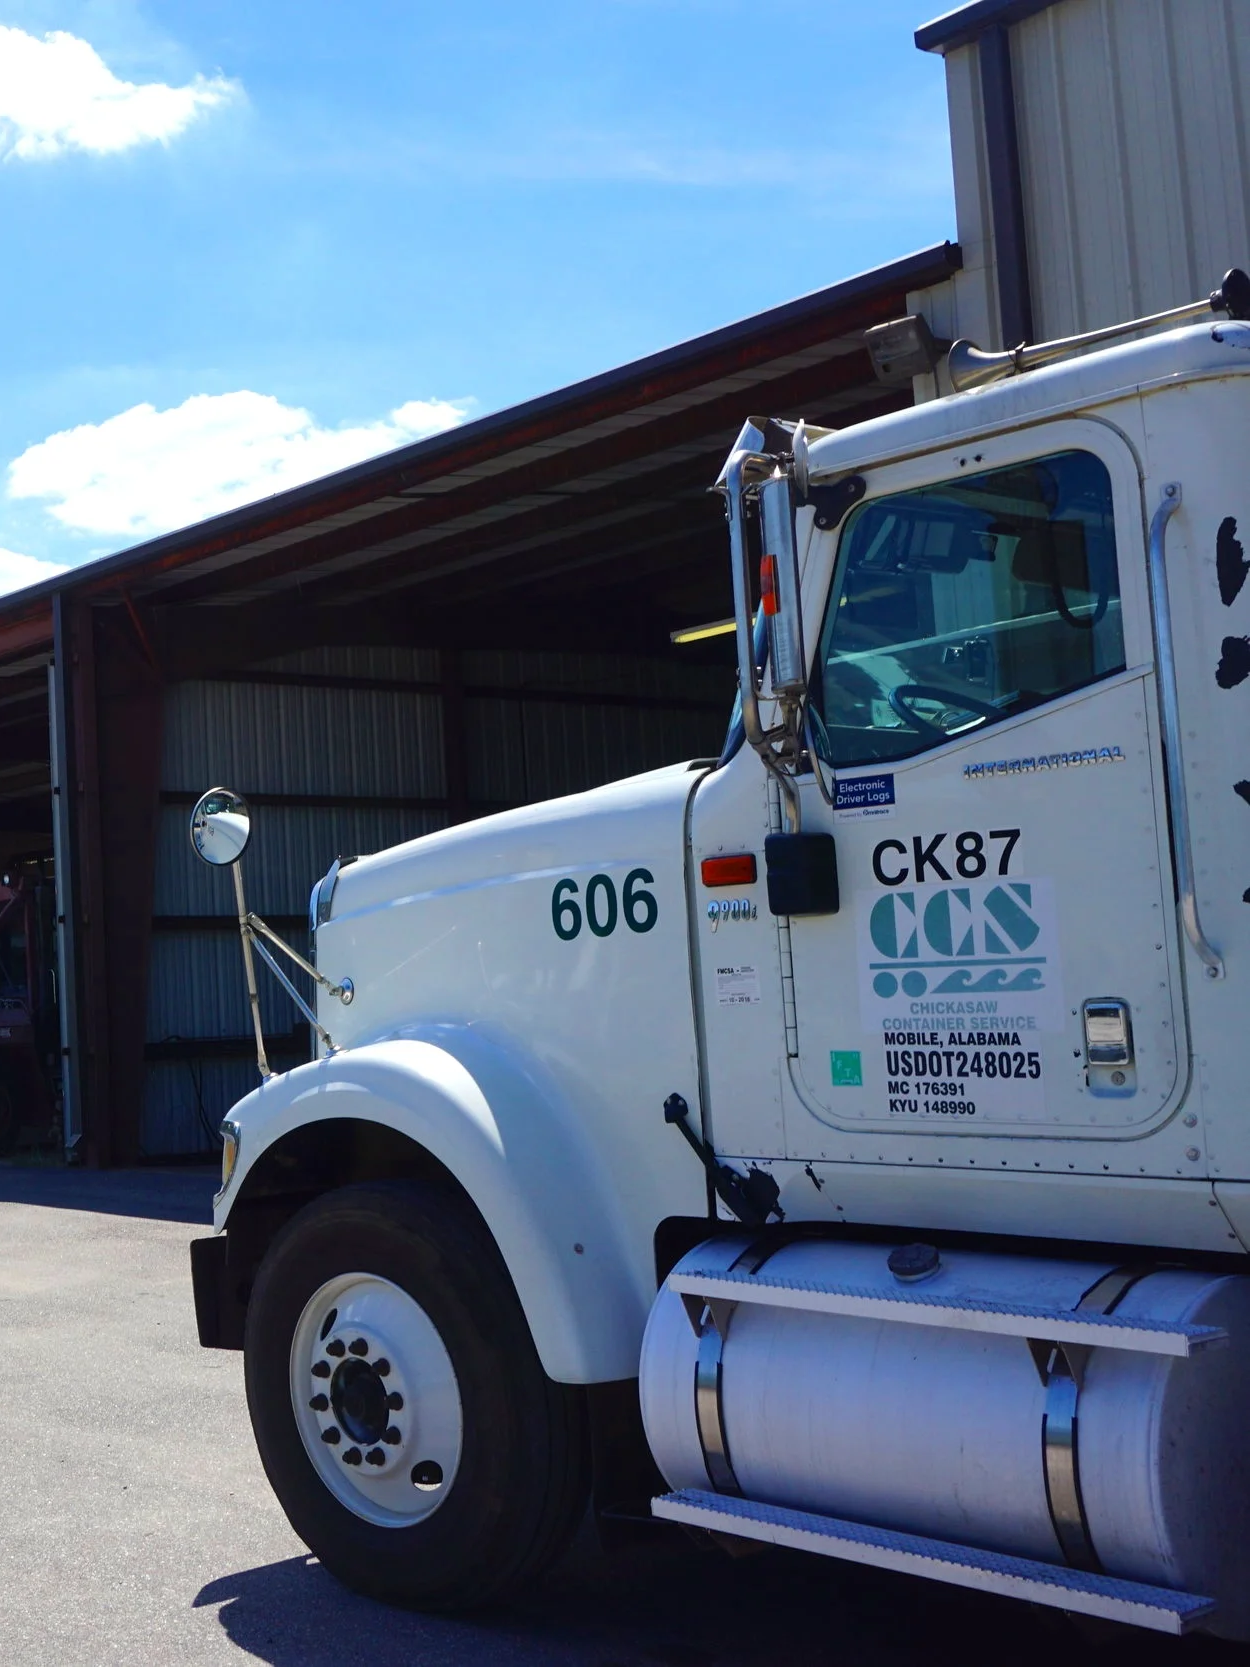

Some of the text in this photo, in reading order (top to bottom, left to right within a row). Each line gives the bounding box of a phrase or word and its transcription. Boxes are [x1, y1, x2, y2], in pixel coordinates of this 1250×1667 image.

[963, 746, 1126, 780] INTERNATIONAL
[839, 780, 886, 793] Electronic
[836, 791, 890, 805] Driver Logs
[872, 828, 1021, 886] CK87
[551, 867, 659, 941] 606
[707, 899, 758, 934] 9900i
[870, 883, 1040, 959] CCS
[717, 967, 735, 975] FMCSA
[910, 1001, 998, 1015] CHICKASAW
[882, 1016, 1036, 1031] CONTAINER SERVICE
[884, 1032, 1022, 1048] MOBILE, ALABAMA
[886, 1051, 1042, 1079] USDOT248025
[887, 1081, 965, 1096] MC 176391
[889, 1099, 976, 1115] KYU 148990
